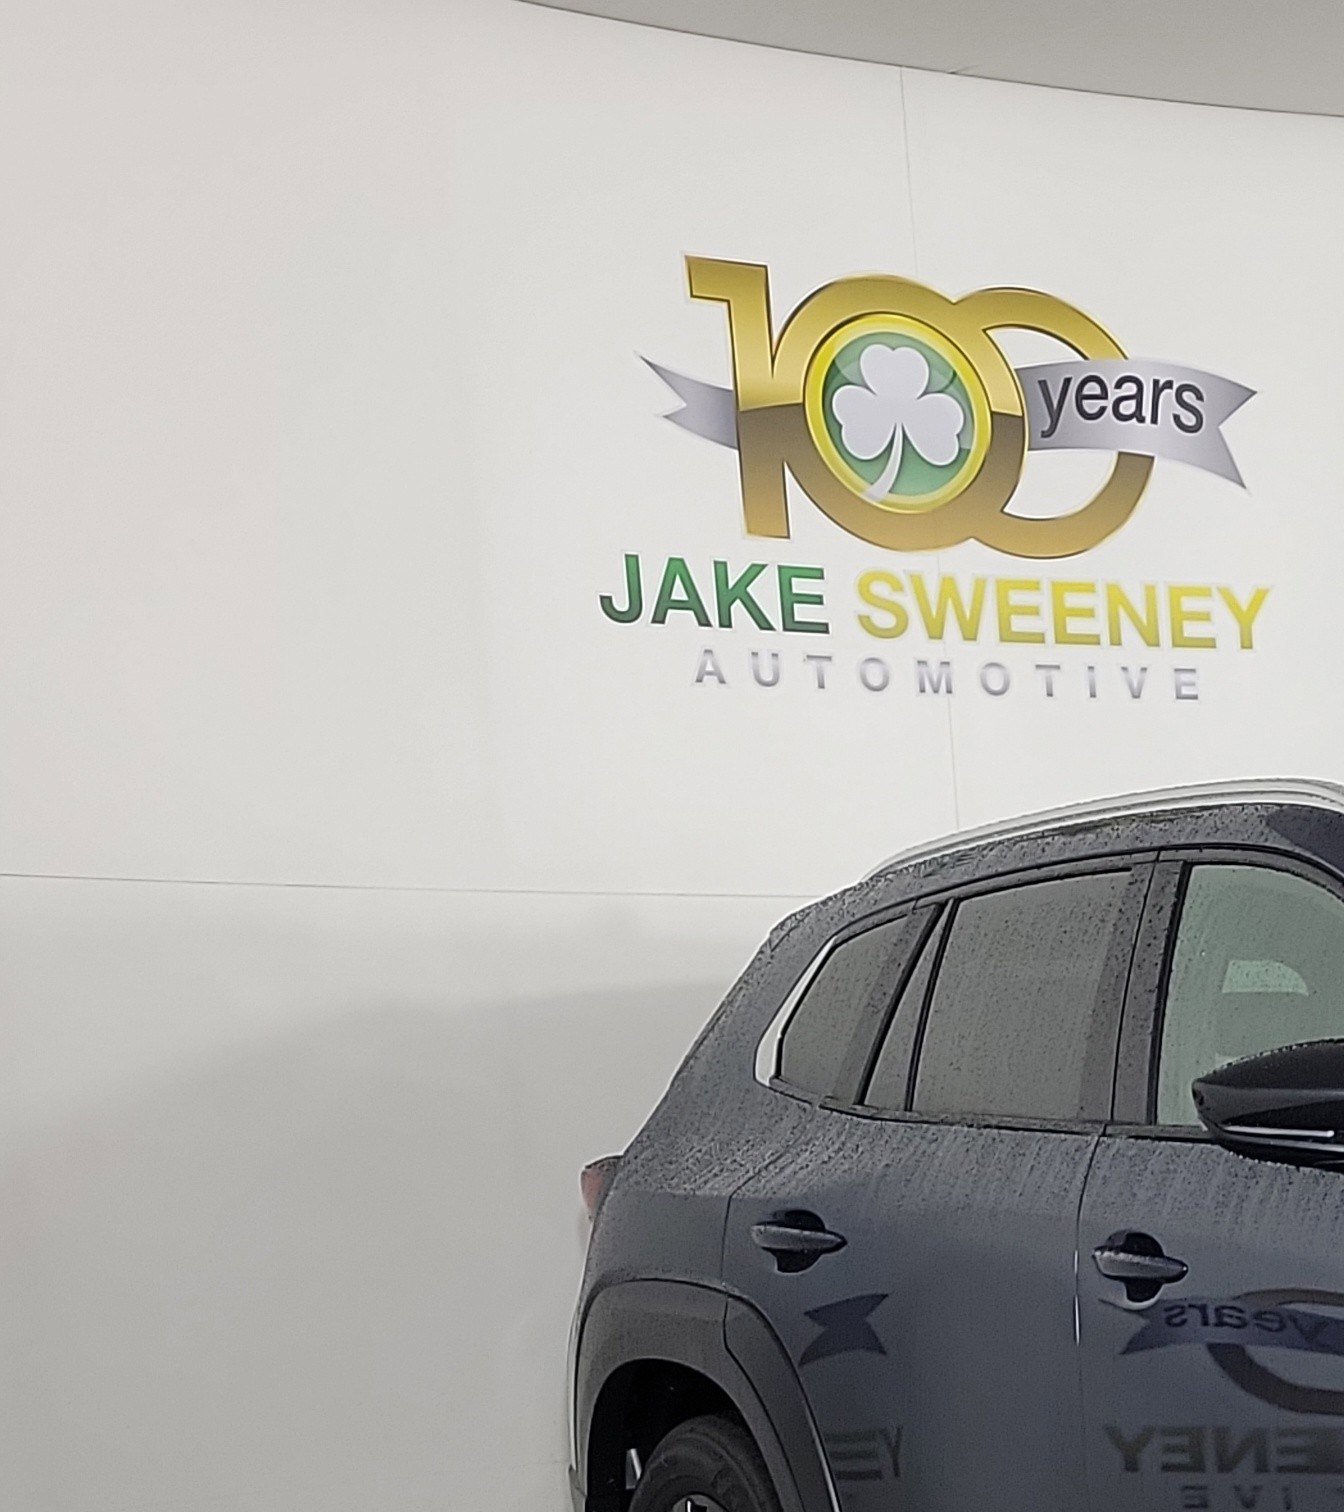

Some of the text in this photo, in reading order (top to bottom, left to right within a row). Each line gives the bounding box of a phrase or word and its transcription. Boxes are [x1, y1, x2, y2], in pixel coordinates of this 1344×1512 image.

[684, 254, 1155, 560] 100
[1037, 370, 1206, 438] years
[599, 553, 1271, 650] JAKE SWEENEY
[695, 649, 1199, 700] AUTOMOTIVE
